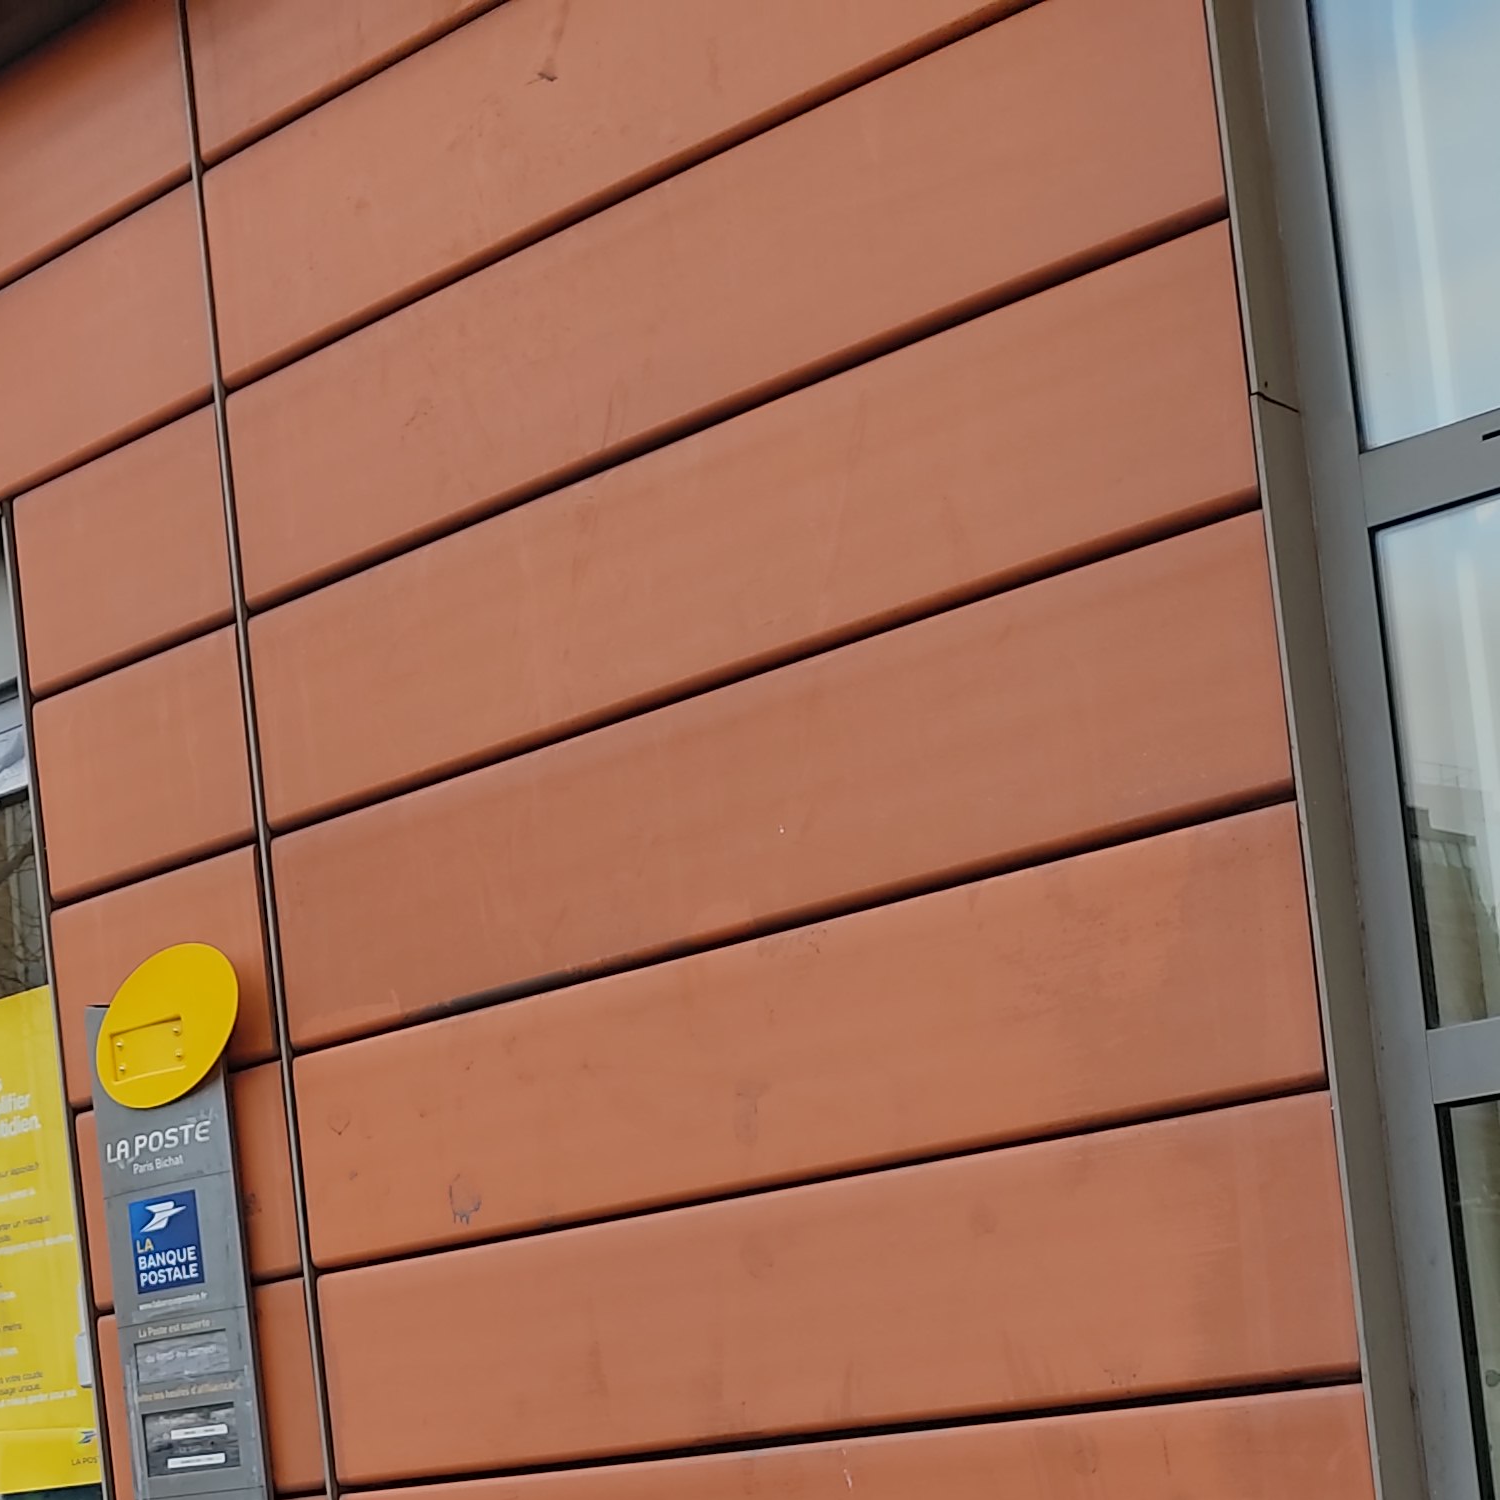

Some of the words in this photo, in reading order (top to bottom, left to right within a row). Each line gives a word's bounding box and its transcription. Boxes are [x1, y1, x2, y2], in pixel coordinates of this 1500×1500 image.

[107, 1140, 129, 1163] LA
[134, 1120, 211, 1157] POSTE
[132, 1160, 155, 1175] Paris
[155, 1154, 184, 1170] Bichat
[136, 1238, 155, 1254] LA
[138, 1245, 197, 1271] BANQUE
[140, 1262, 199, 1288] POSTALE
[139, 1328, 148, 1339] La
[148, 1325, 168, 1338] Poste
[169, 1322, 181, 1334] est
